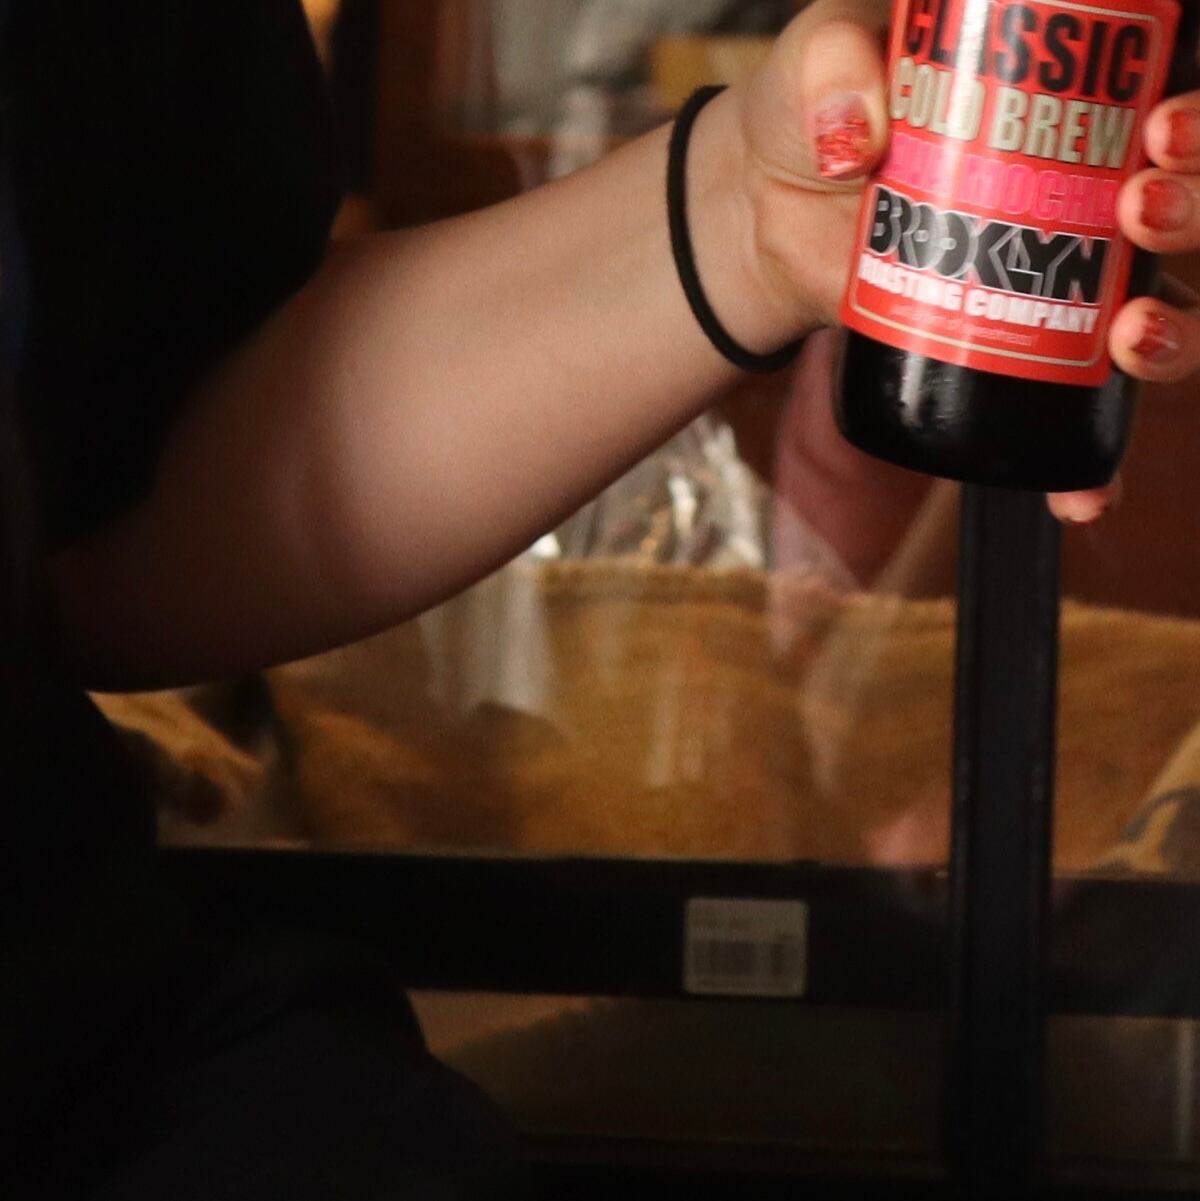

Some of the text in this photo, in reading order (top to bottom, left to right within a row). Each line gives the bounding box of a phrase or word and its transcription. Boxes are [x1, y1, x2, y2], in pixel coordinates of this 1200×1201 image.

[889, 56, 986, 141] COLD
[989, 86, 1136, 169] BREW
[964, 288, 1100, 334] COMPANY
